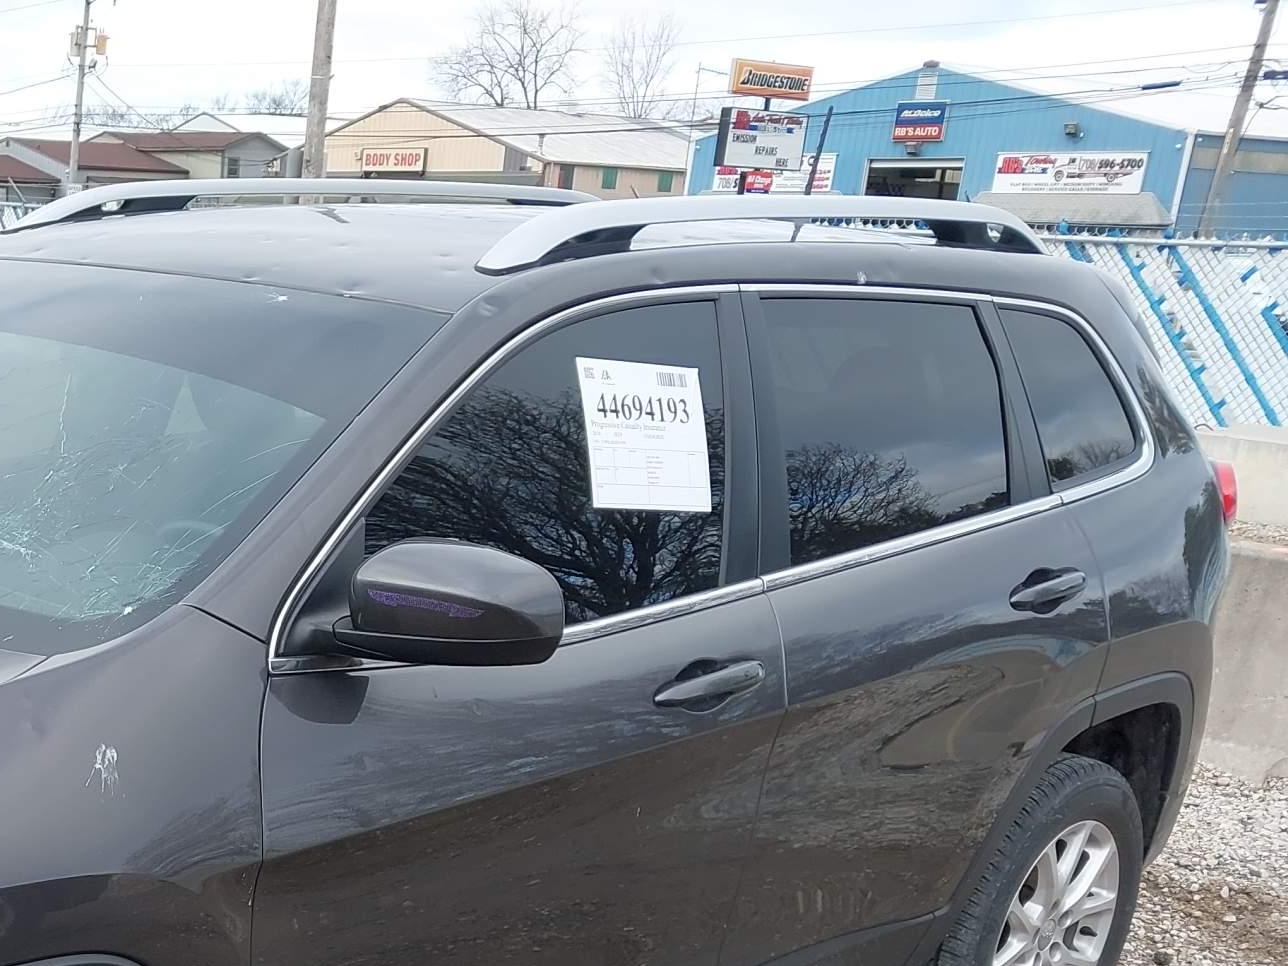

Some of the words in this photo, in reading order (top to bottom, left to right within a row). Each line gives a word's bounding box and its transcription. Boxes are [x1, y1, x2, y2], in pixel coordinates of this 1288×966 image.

[740, 69, 809, 91] BRIDGESTONE
[914, 127, 939, 136] AUTO
[732, 133, 758, 144] EMISSION
[754, 146, 778, 156] REPAIRS
[365, 153, 391, 166] BODY
[393, 153, 421, 166] SHOP
[775, 158, 789, 168] HERE
[596, 392, 690, 424] 44694193
